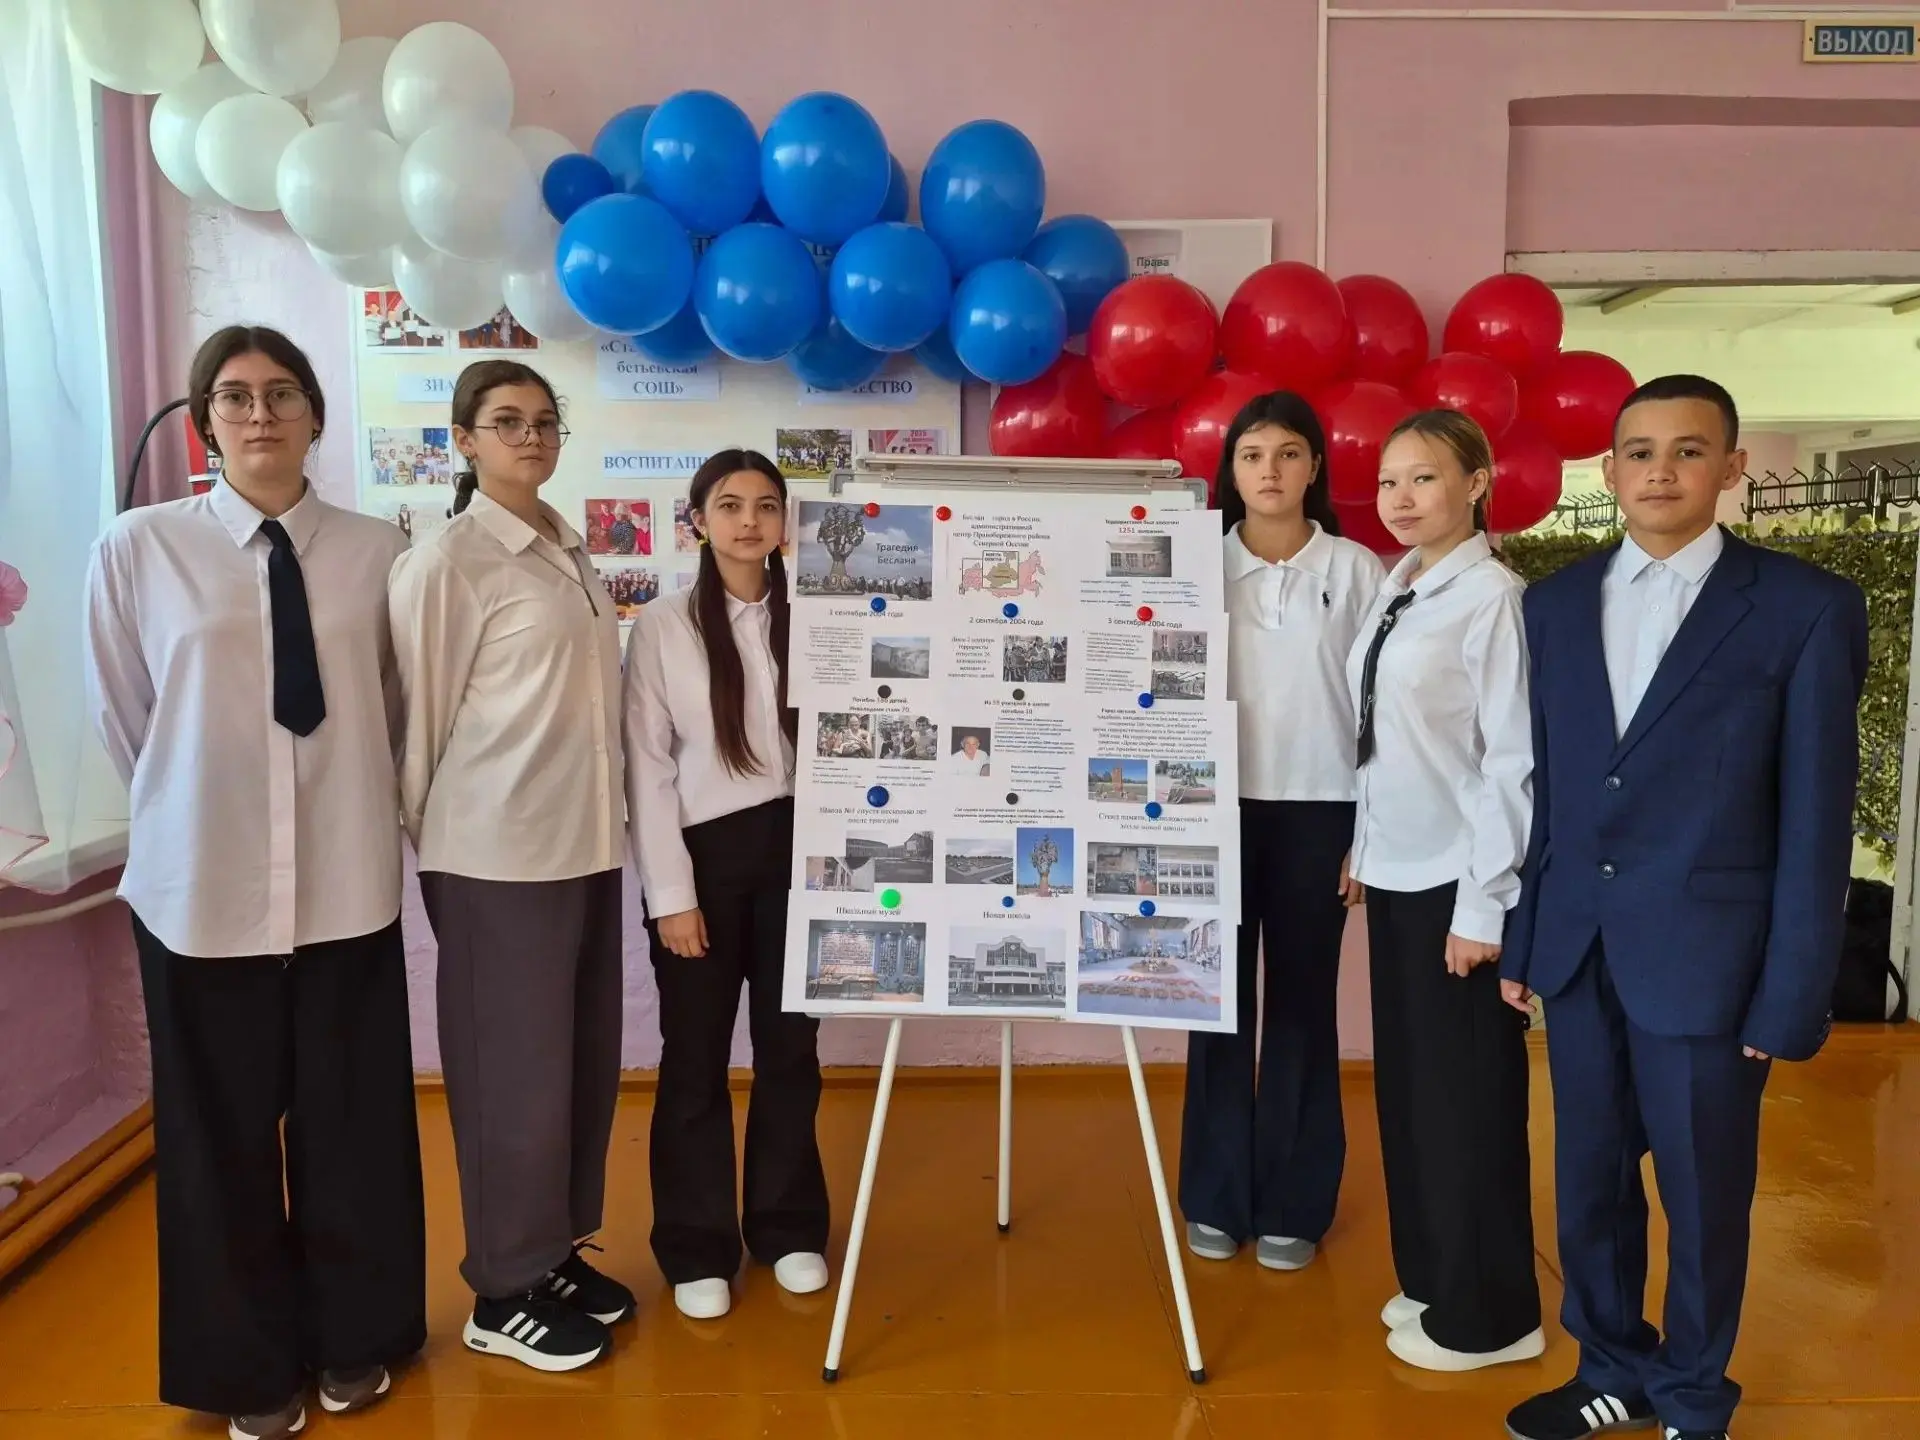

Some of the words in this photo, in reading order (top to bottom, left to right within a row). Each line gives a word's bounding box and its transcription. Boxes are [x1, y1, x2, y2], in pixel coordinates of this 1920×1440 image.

[1818, 30, 1909, 55] ВЫХОД
[1136, 256, 1170, 268] Права
[633, 381, 684, 395] СОШ»
[876, 543, 919, 554] Трагедия
[877, 556, 916, 565] Беслана
[1114, 618, 1146, 628] сентября
[983, 911, 1006, 919] Новая
